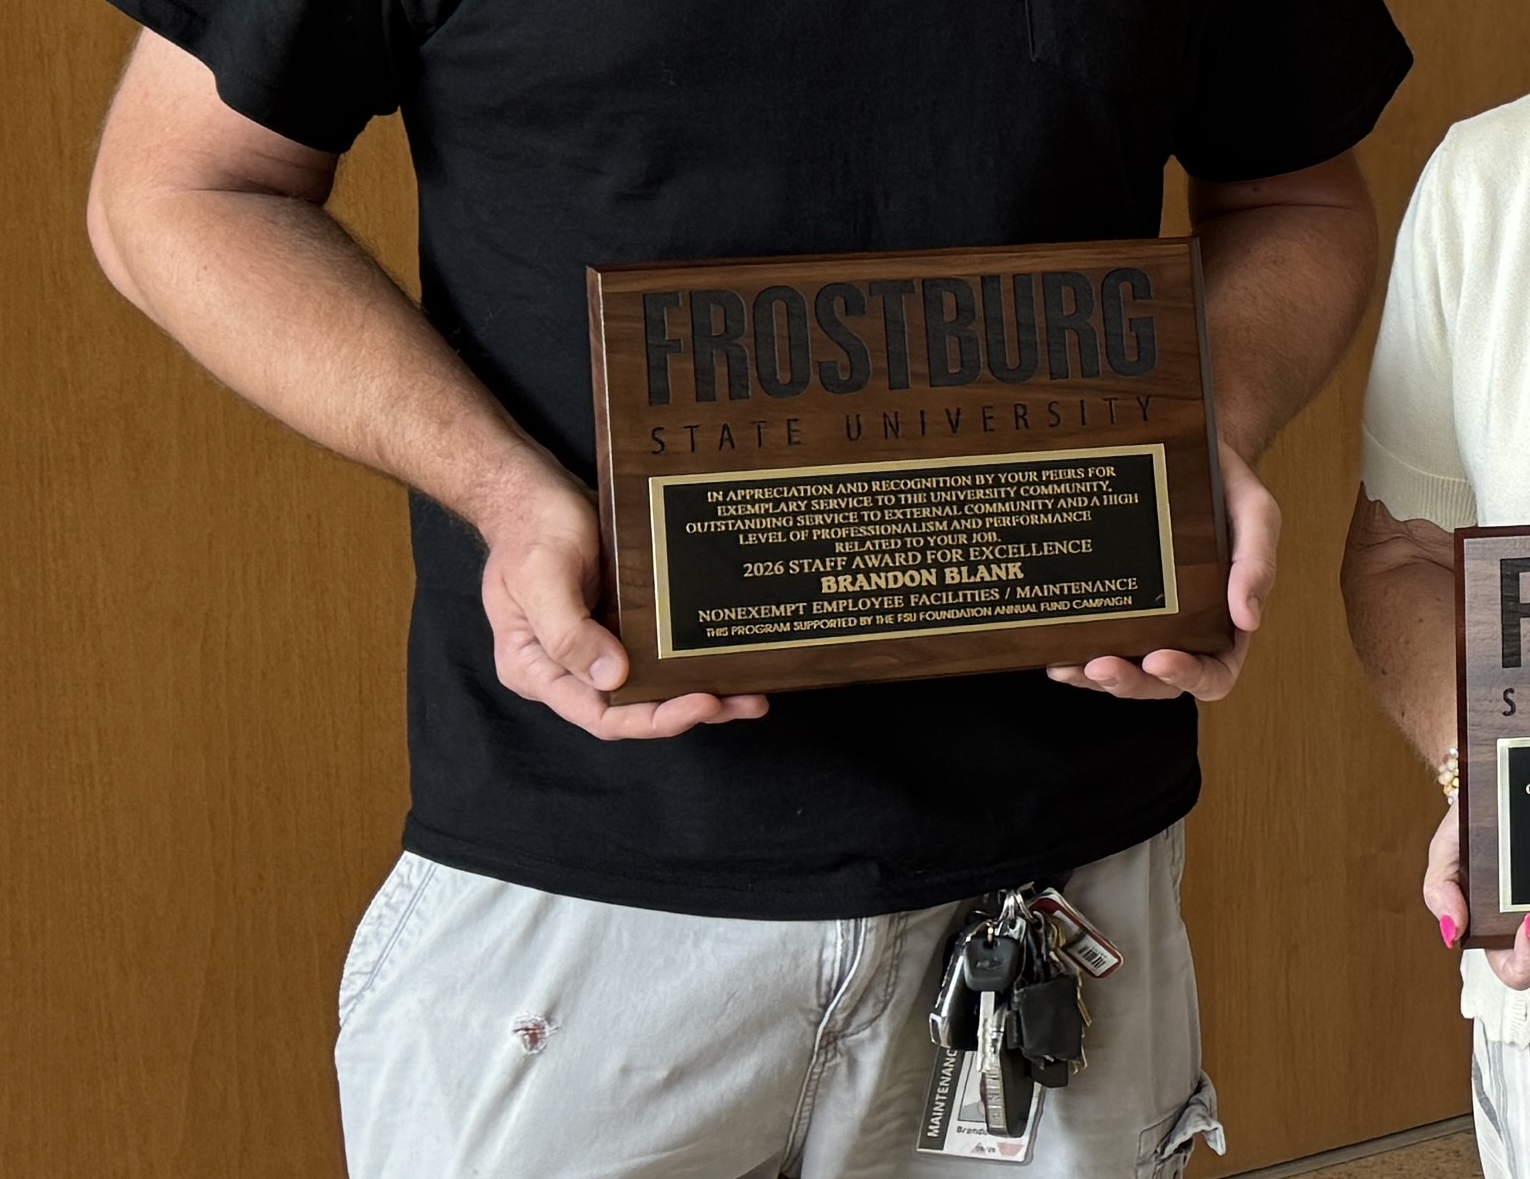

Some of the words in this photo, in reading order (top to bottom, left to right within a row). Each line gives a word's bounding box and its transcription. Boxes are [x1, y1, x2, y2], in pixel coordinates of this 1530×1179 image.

[642, 268, 1157, 406] FROSTBURG
[651, 418, 802, 455] STATE
[845, 397, 1156, 443] UNIVERSITY
[706, 490, 724, 504] IN
[725, 483, 834, 502] APPRECIATION
[835, 481, 869, 495] AND
[870, 474, 972, 492] RECOGNITION
[974, 472, 995, 485] BY
[997, 469, 1039, 484] YOUR
[1040, 466, 1085, 481] PEERS
[1087, 464, 1116, 477] FOR
[716, 499, 808, 518] EXEMPLARY
[810, 495, 873, 511] SERVICE
[874, 493, 896, 507] TO
[896, 491, 927, 505] THE
[929, 485, 1018, 503] UNIVERSITY
[684, 515, 794, 536] OUTSTANDING
[795, 510, 859, 528] SERVICE
[859, 509, 882, 523] TO
[883, 503, 962, 521] EXTERNAL
[963, 496, 1055, 515] COMMUNITY
[1056, 494, 1089, 509] AND
[1102, 490, 1139, 505] HIGH
[738, 531, 787, 546] LEVEL
[788, 529, 810, 543] OF
[811, 519, 948, 541] PROFESSIONALISM
[949, 516, 983, 531] AND
[984, 508, 1092, 528] PERFORMANCE
[742, 560, 785, 579] 2026
[788, 555, 848, 575] STAFF
[850, 550, 922, 570] AWARD
[925, 546, 965, 565] FOR
[968, 536, 1093, 561] EXCELLENCE
[834, 537, 902, 554] RELATED
[903, 535, 925, 549] TO
[926, 532, 968, 547] YOUR
[819, 567, 938, 595] BRANDON
[943, 560, 1024, 585] BLANK
[697, 601, 808, 625] NONEXEMPT
[811, 593, 905, 616] EMPLOYEE
[909, 586, 1000, 608] FACILITIES
[1015, 574, 1138, 599] MAINTENANCE
[927, 1049, 958, 1137] MAINTENANC
